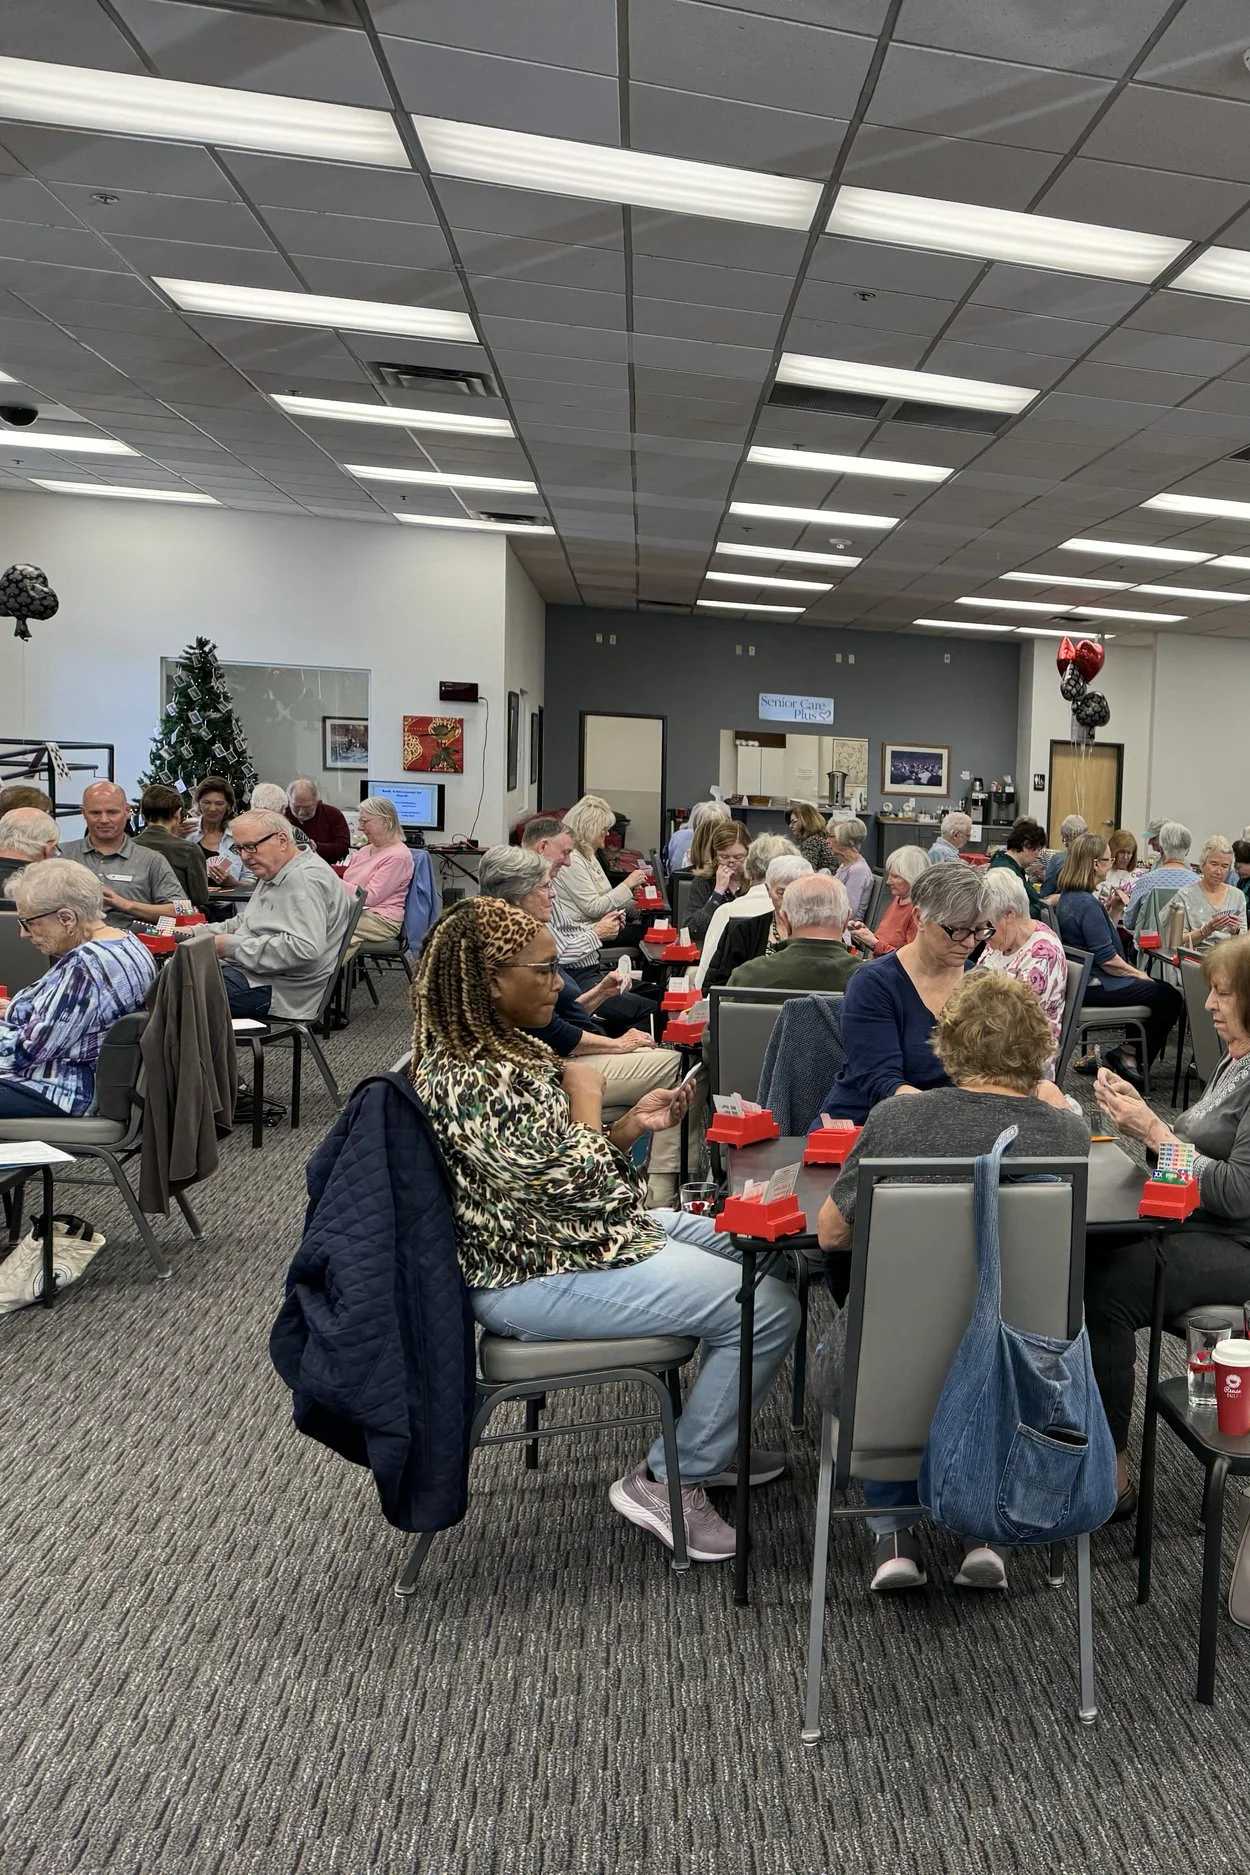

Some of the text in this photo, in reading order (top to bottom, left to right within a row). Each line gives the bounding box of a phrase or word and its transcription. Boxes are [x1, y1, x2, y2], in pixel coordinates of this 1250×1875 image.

[761, 696, 826, 711] Senior Care
[794, 709, 817, 721] Plus
